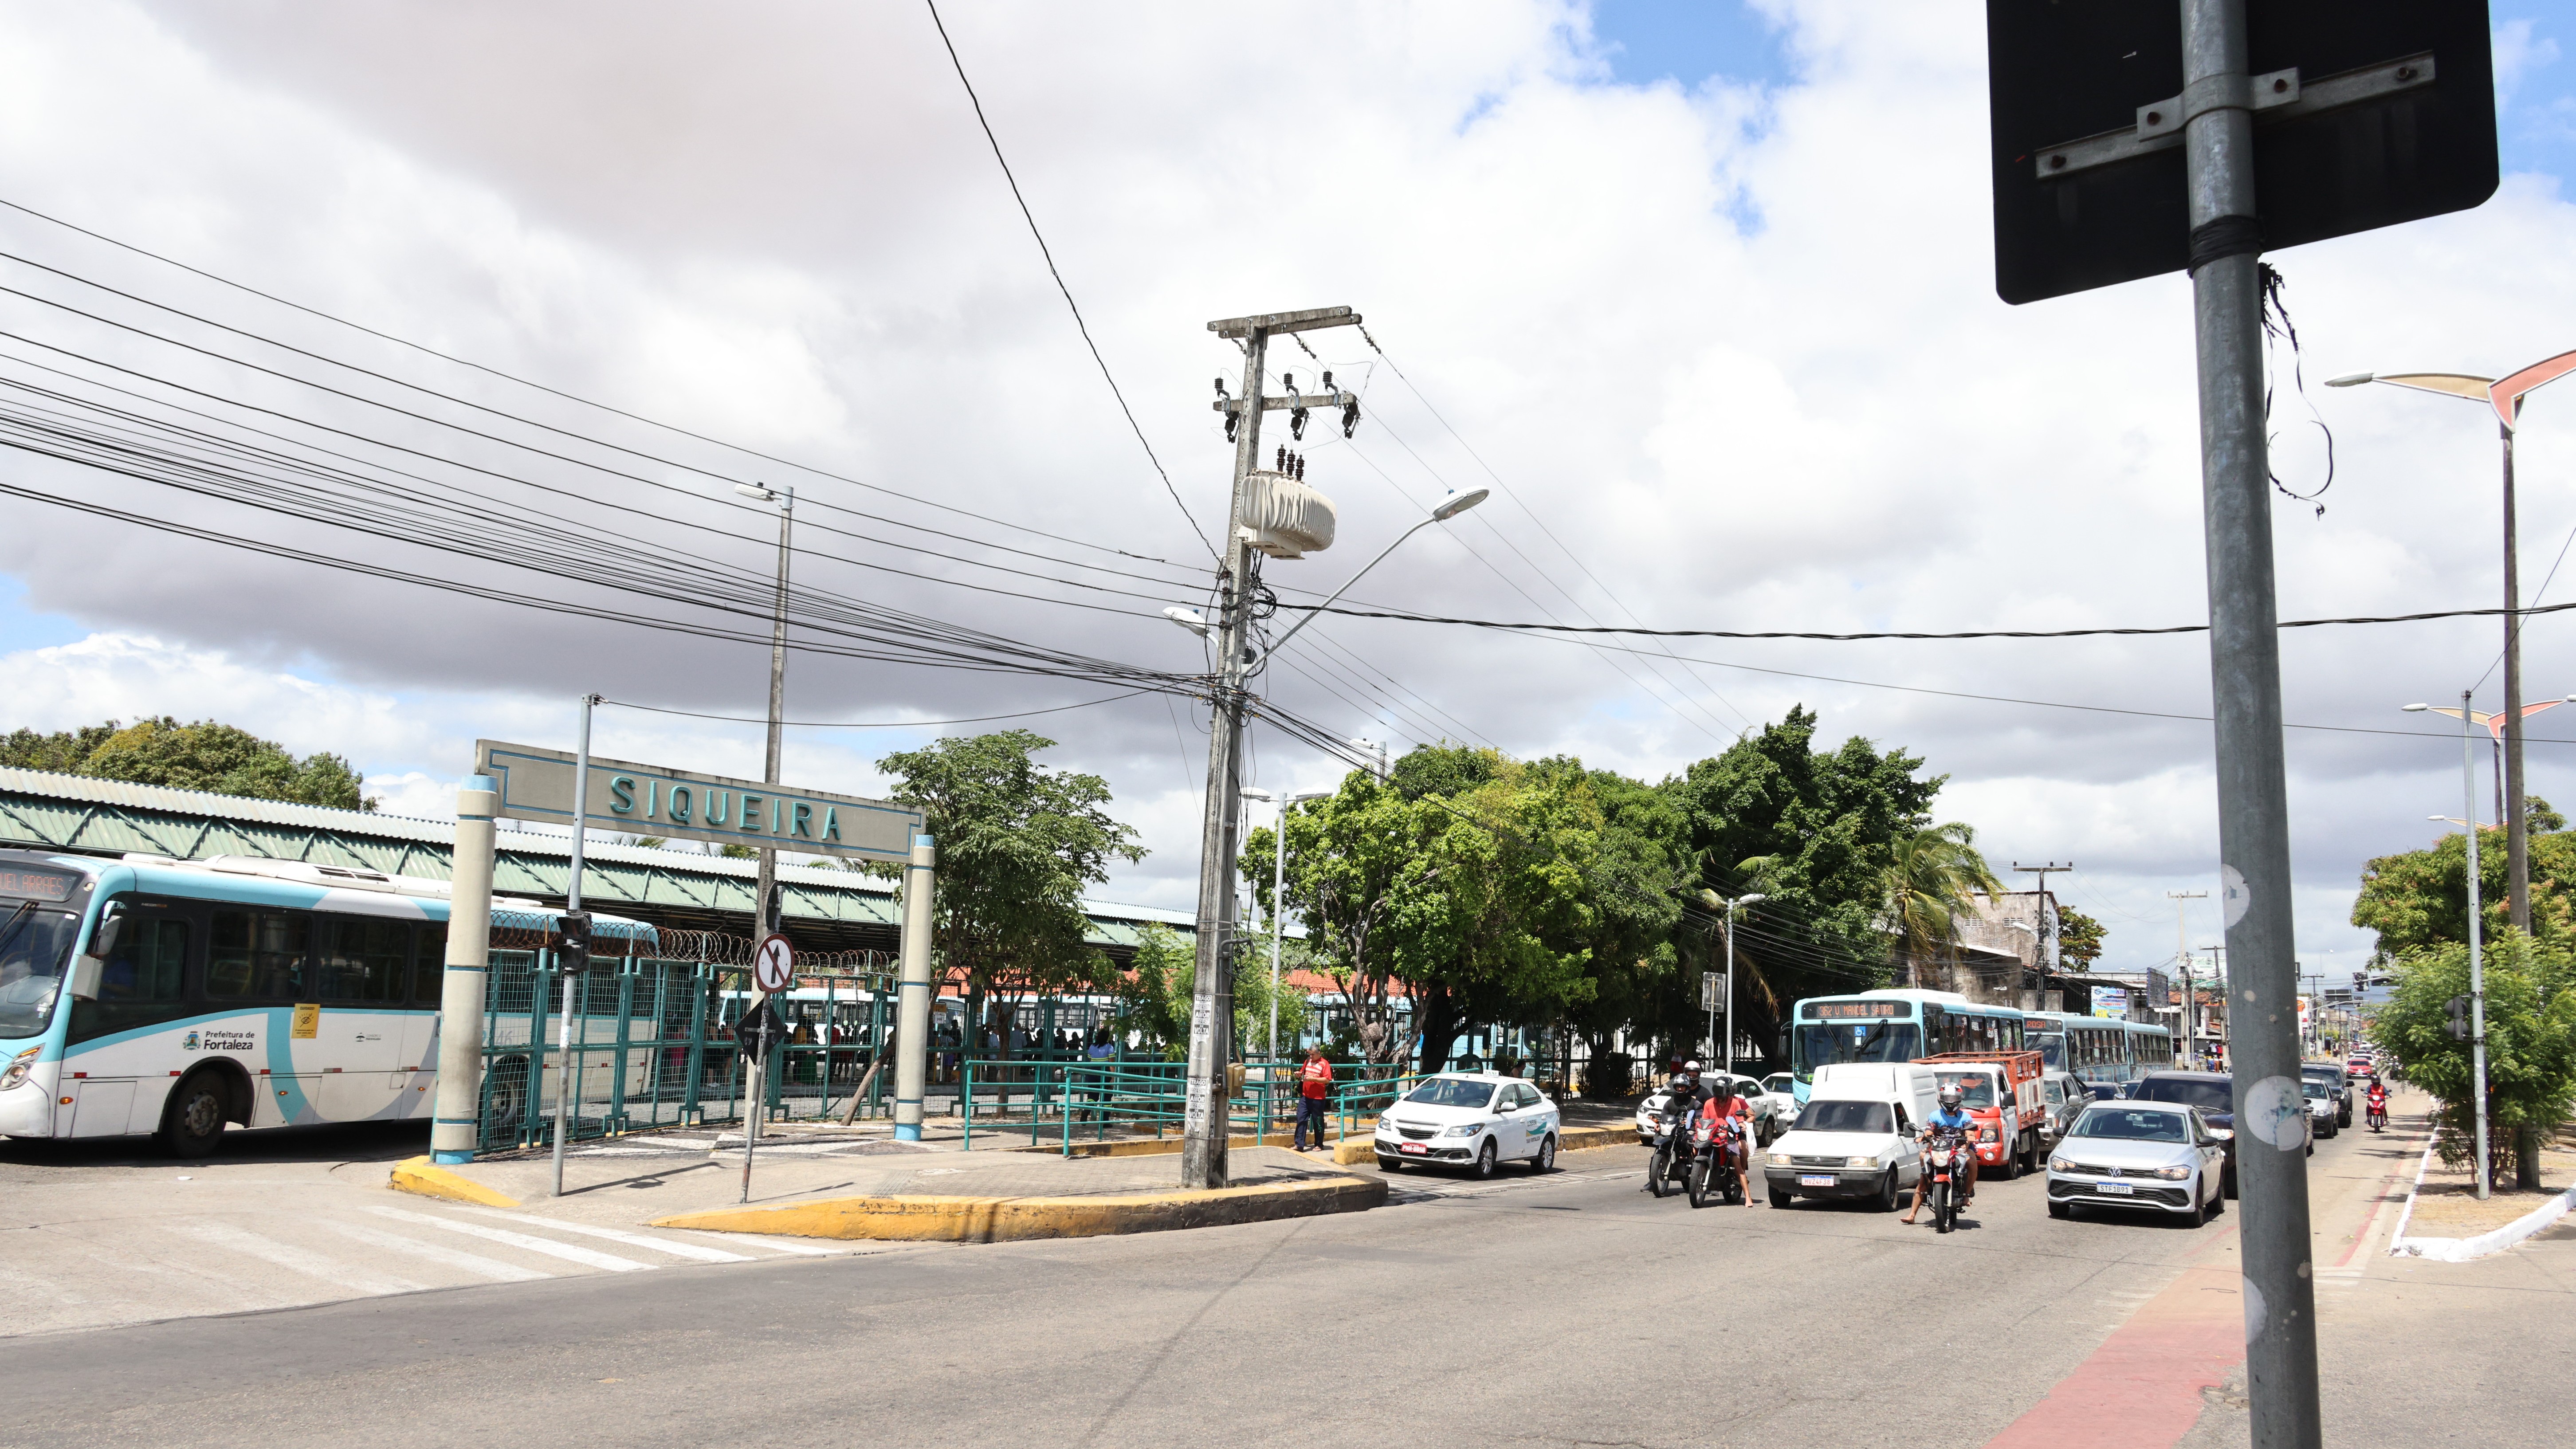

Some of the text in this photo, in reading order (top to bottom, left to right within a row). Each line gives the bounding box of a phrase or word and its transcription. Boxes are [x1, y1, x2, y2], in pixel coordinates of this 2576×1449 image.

[609, 775, 841, 840] SIQUEIRA
[23, 875, 64, 895] ARRAES
[1820, 1006, 1832, 1016] 362
[1843, 1005, 1869, 1016] MANOEL
[204, 1039, 253, 1050] Fortaleza
